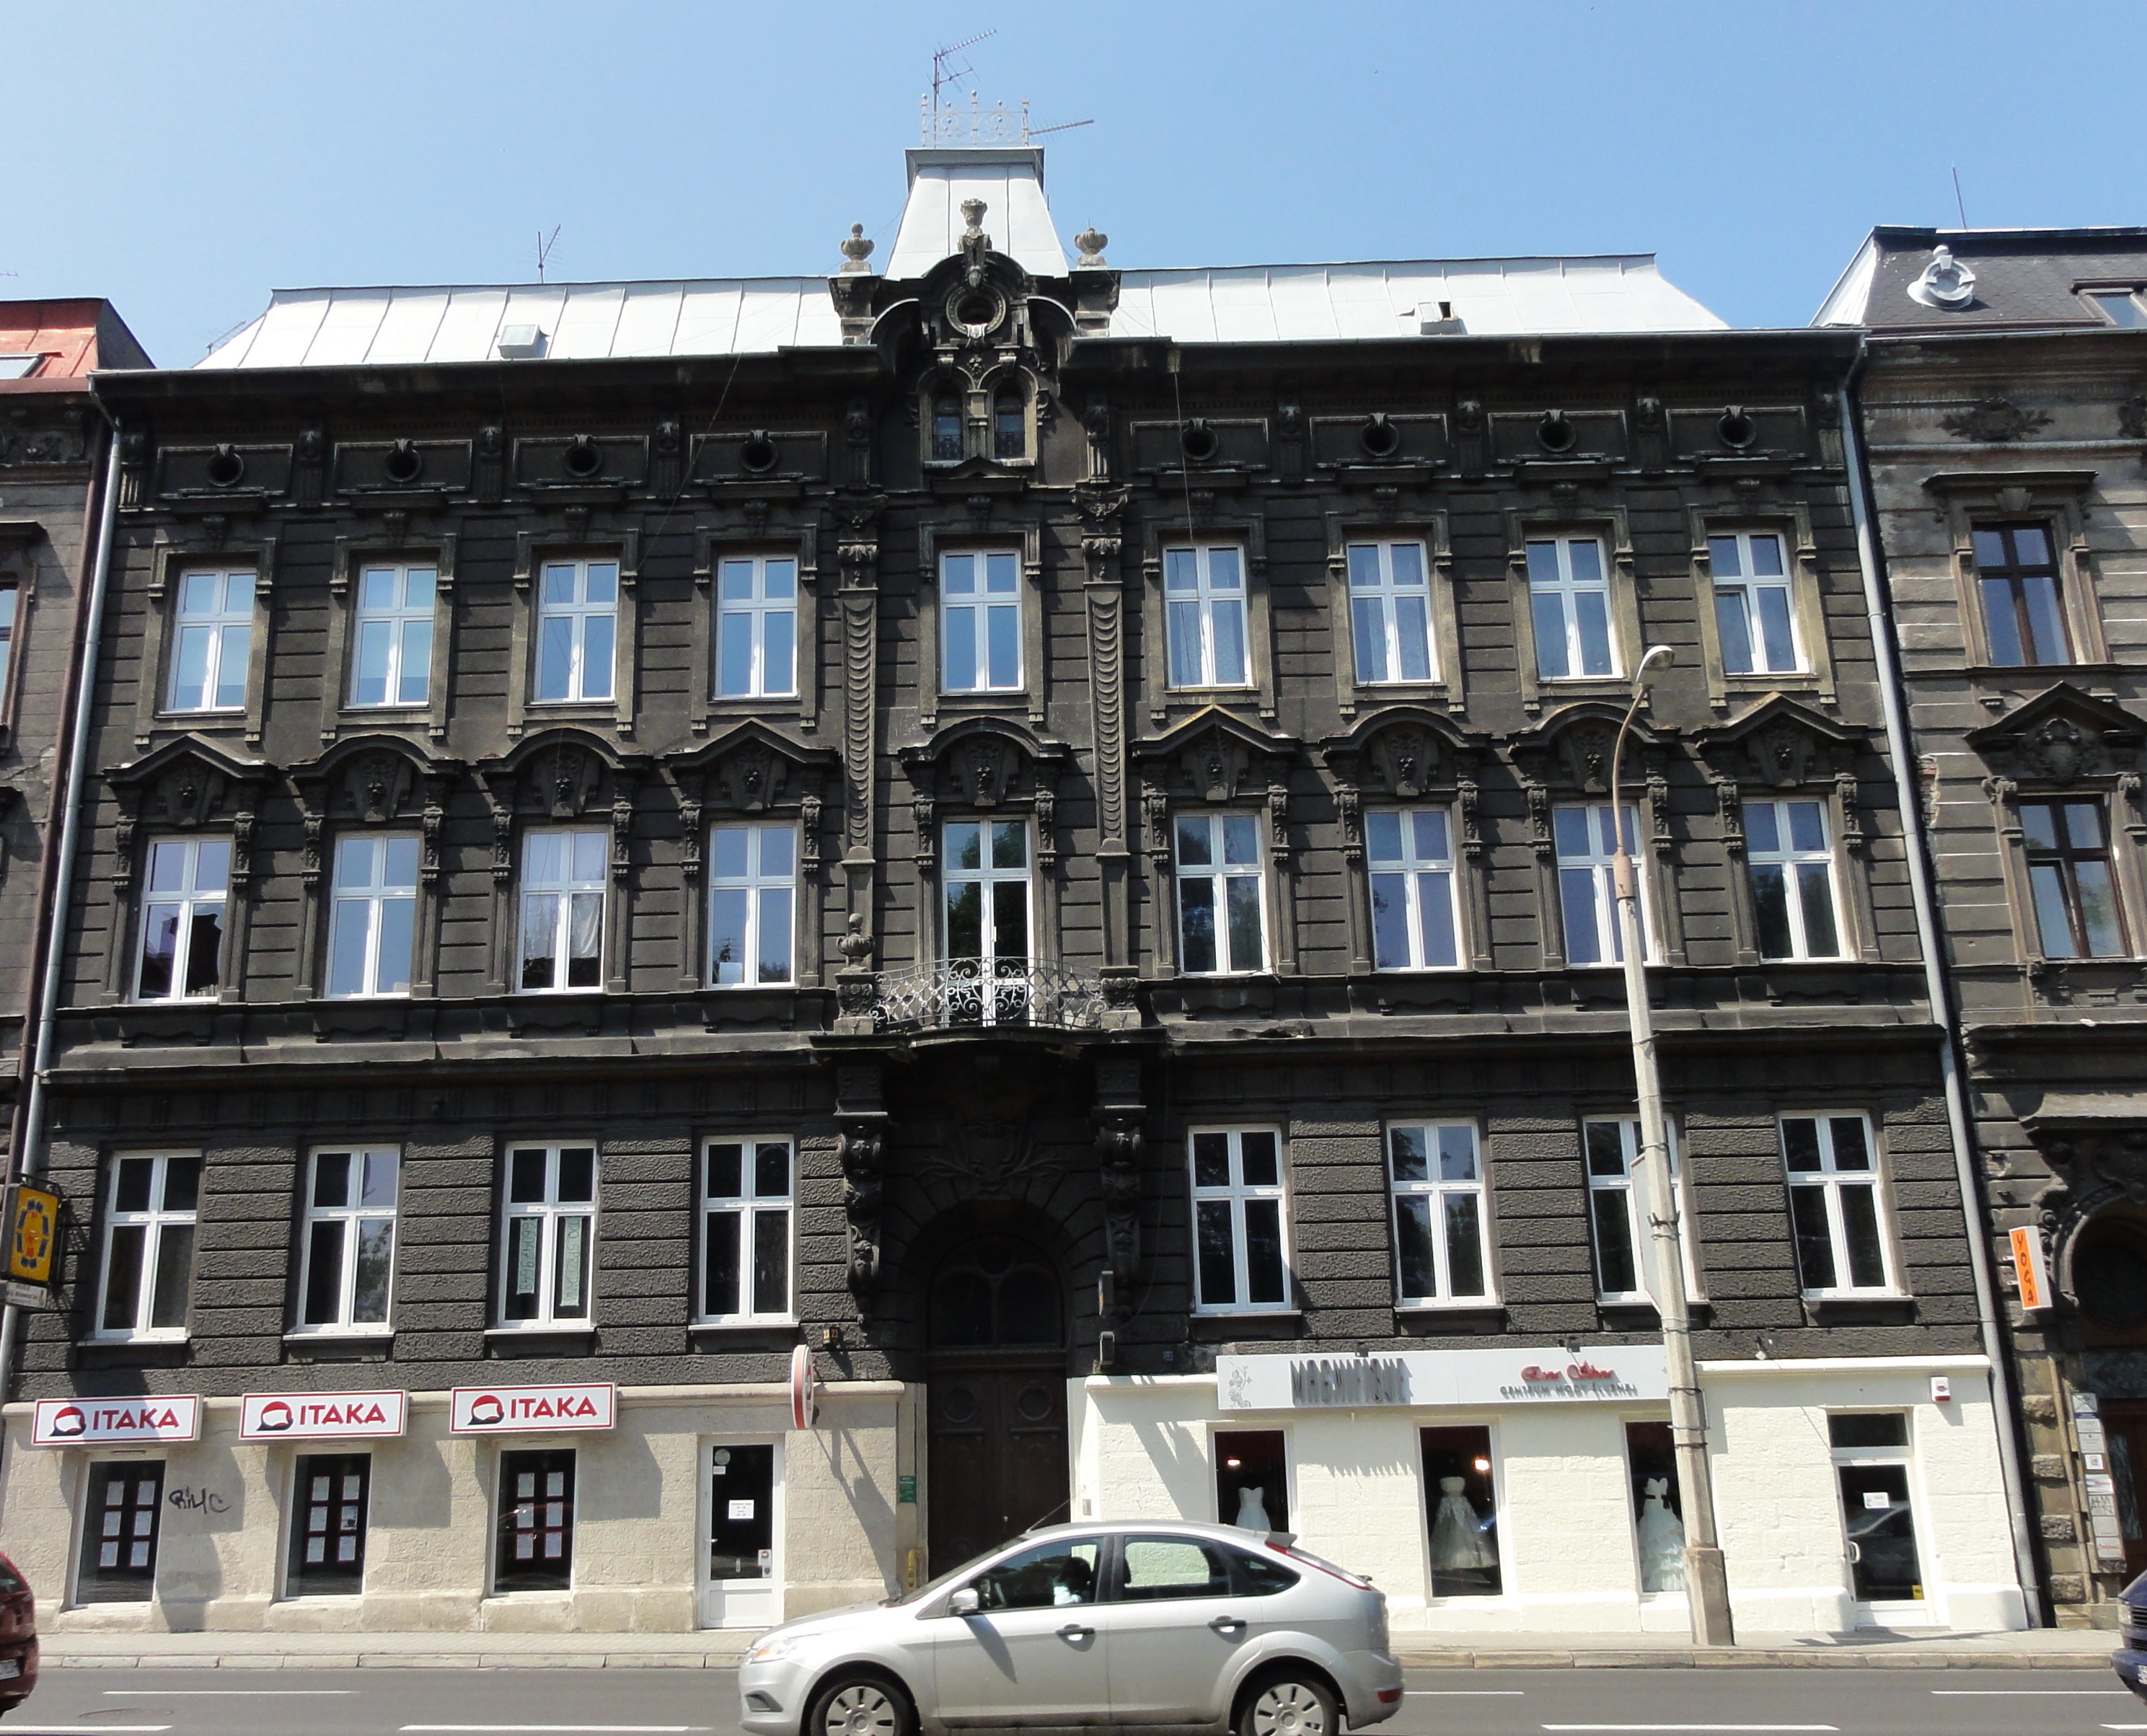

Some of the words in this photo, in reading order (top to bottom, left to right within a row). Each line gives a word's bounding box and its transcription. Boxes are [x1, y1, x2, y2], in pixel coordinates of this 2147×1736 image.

[2016, 1232, 2035, 1304] YOGA
[92, 1407, 180, 1431] ITAKA
[299, 1402, 387, 1425] ITAKA
[511, 1396, 598, 1419] ITAKA
